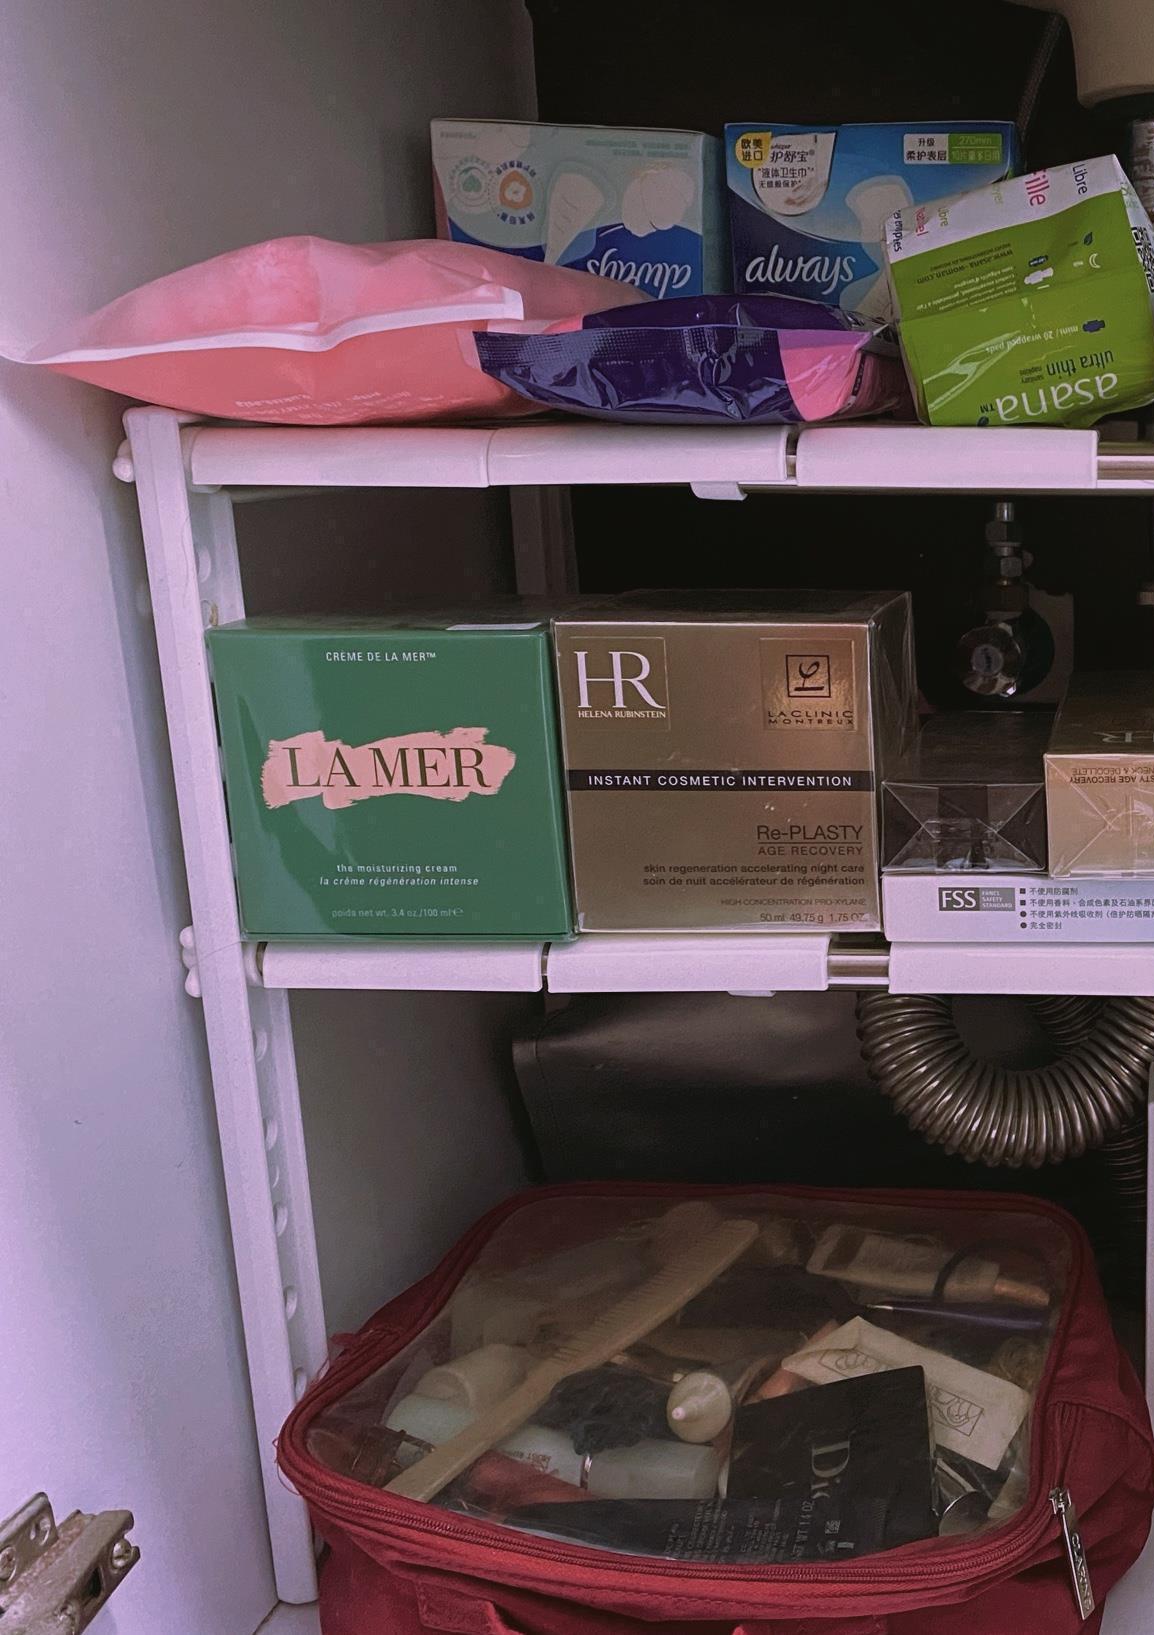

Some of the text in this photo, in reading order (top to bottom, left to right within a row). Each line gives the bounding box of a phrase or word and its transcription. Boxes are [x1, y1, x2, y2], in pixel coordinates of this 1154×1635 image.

[740, 138, 763, 150] 欧美
[918, 138, 935, 147] 升级
[741, 150, 764, 162] 进口
[905, 150, 948, 162] 柔护表层
[1071, 163, 1088, 195] Libre
[586, 247, 692, 300] always
[745, 244, 857, 296] always
[1046, 349, 1115, 380] ultra thin
[995, 372, 1119, 423] asana
[367, 651, 381, 662] DE
[385, 651, 399, 662] LA
[574, 651, 666, 709] HR
[578, 710, 666, 719] HELENA RUBINSTEIN
[768, 710, 854, 719] LACLINIC
[281, 746, 491, 788] LA MER
[588, 774, 853, 787] INSTANT COSMETIC INTERVENTION
[1069, 775, 1117, 784] RECOVERY
[1118, 775, 1138, 783] AGE
[756, 825, 864, 841] Re-PLASTY
[758, 846, 864, 856] AGE RECOVERY
[336, 863, 457, 874] the moisturizing cream
[644, 864, 865, 875] skin regeneration accelerating night care
[320, 877, 329, 886] la
[440, 877, 479, 886] intense
[643, 877, 666, 886] soin
[669, 877, 683, 886] de
[686, 877, 707, 886] nuit
[780, 877, 794, 886] de
[797, 876, 865, 888] régénération
[743, 898, 813, 906] CONCENTRATION
[942, 890, 977, 909] FSS
[358, 909, 373, 918] net
[760, 913, 773, 922] 50
